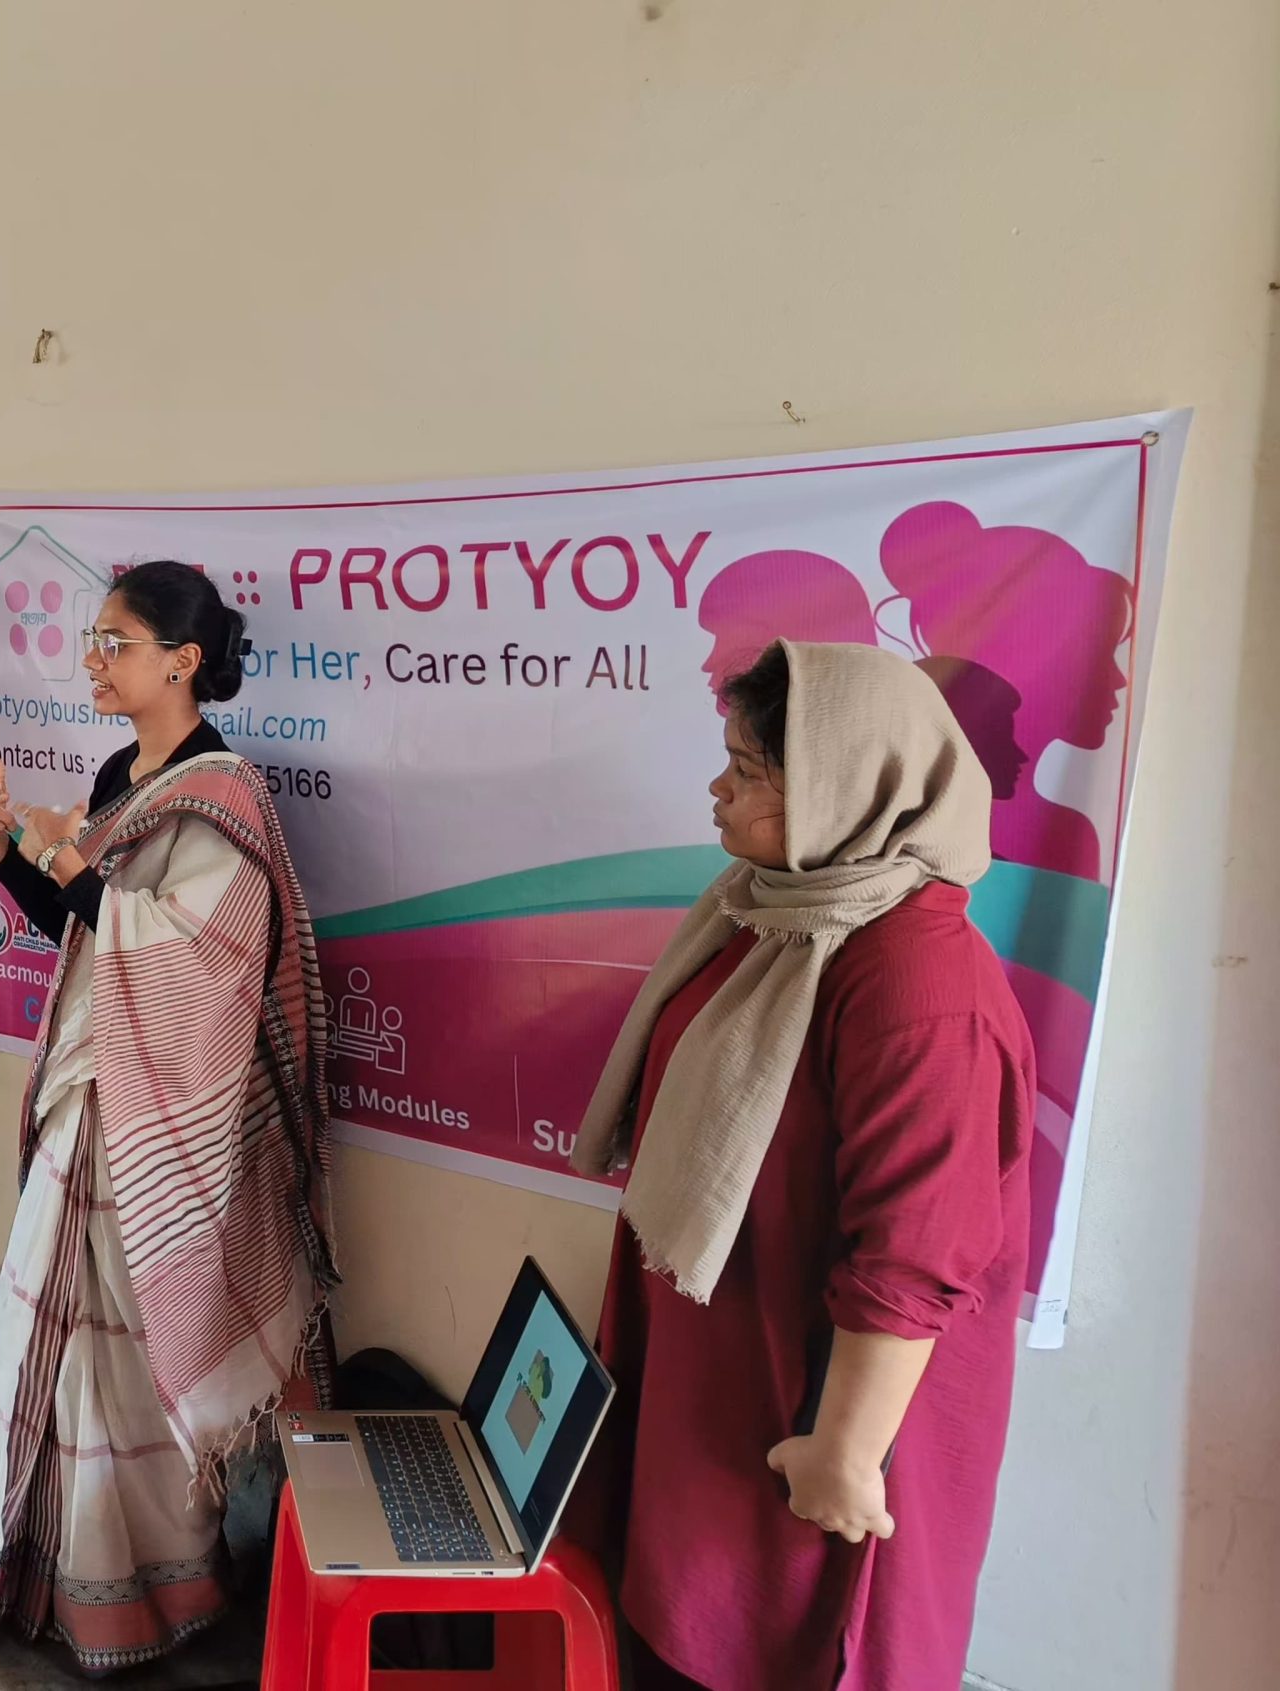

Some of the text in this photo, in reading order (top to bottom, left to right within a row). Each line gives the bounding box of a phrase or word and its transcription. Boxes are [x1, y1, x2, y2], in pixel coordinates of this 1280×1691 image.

[288, 530, 713, 612] PROTYOY
[241, 642, 650, 691] or Her, Care for All
[62, 752, 85, 775] us
[253, 764, 332, 800] 5166
[325, 1083, 470, 1130] ng Modules
[533, 1119, 577, 1157] Su
